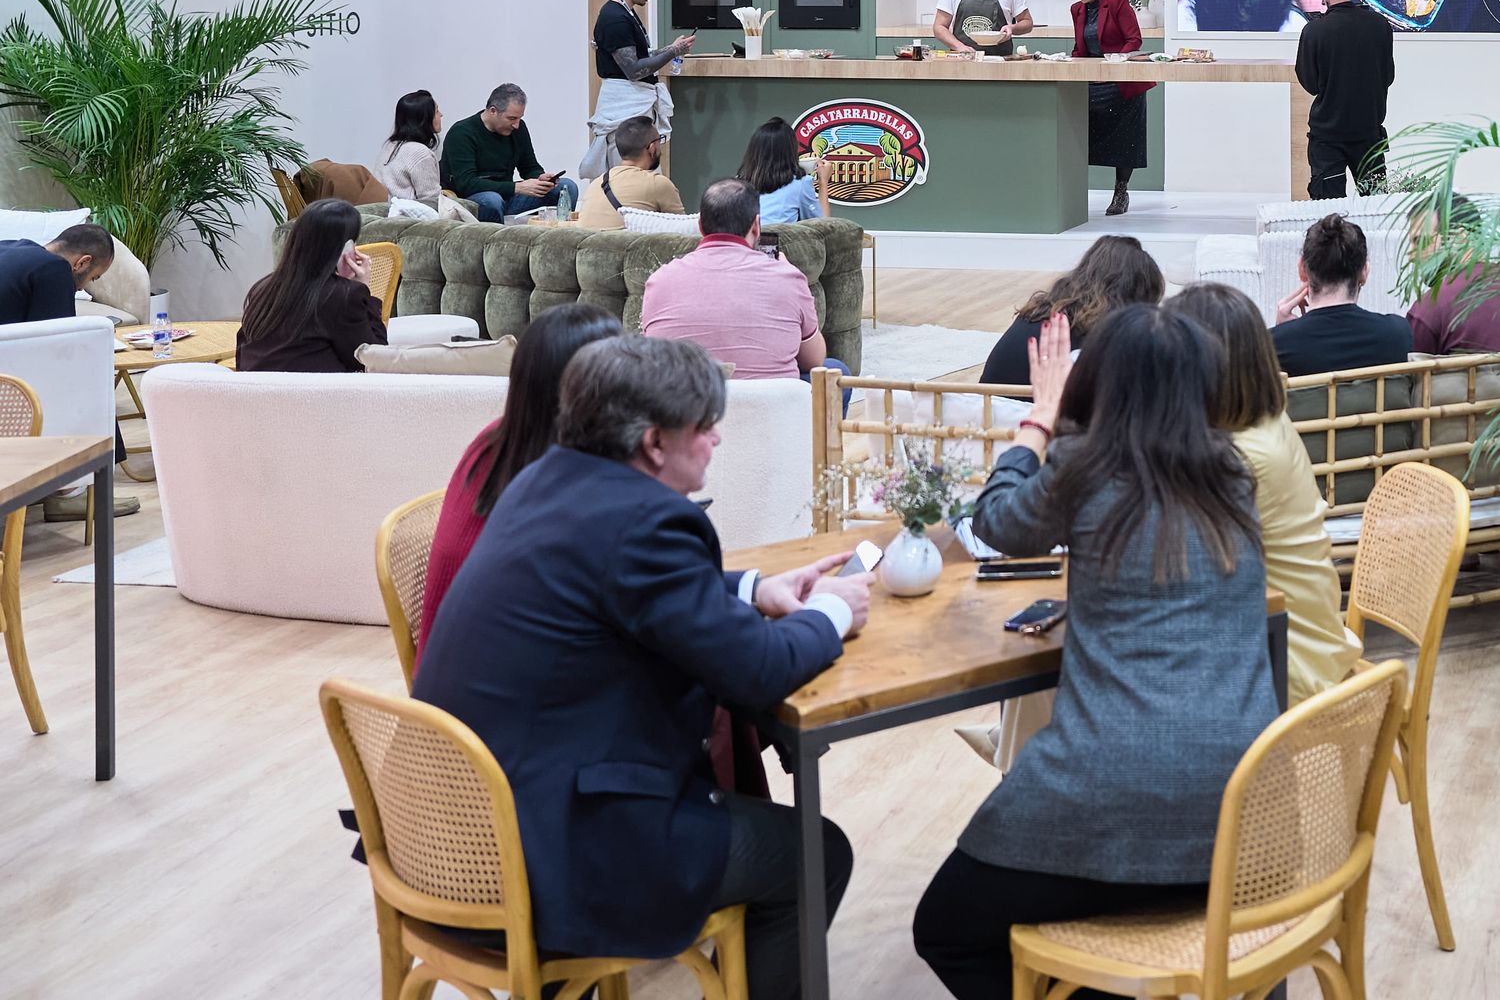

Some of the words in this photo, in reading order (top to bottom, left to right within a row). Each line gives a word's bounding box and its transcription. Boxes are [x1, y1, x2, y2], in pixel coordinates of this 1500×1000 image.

[306, 11, 361, 38] SITIO
[800, 113, 828, 138] CASA
[827, 108, 913, 140] TARRADELLAS
